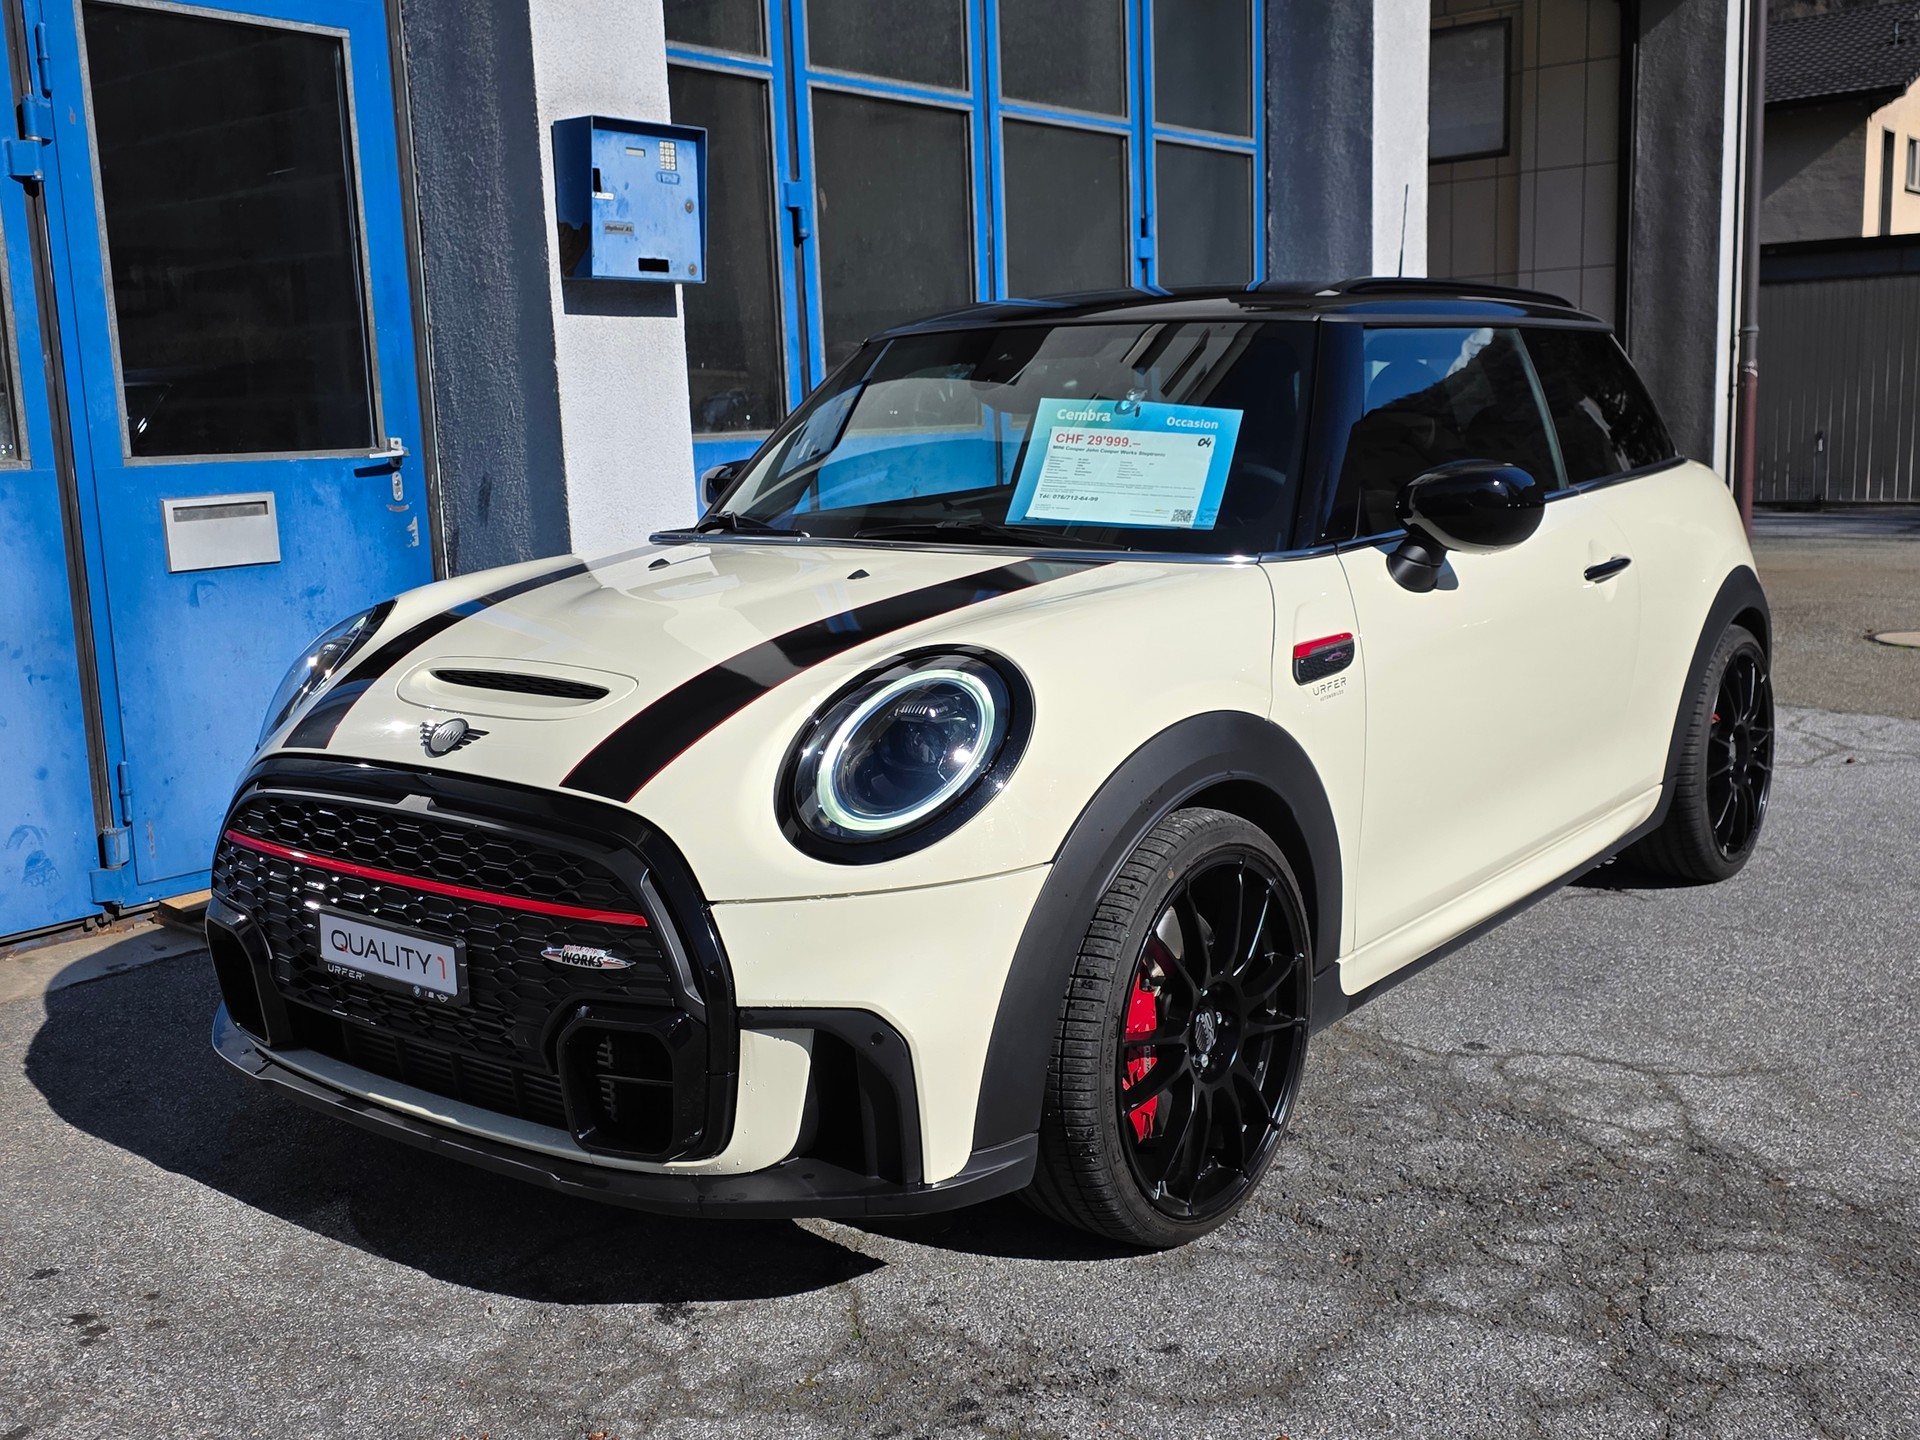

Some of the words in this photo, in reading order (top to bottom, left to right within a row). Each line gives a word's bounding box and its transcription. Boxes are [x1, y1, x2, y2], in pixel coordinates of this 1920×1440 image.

[1056, 408, 1111, 422] Cembra
[1166, 416, 1219, 430] Occasion
[1055, 433, 1085, 444] CHF
[1197, 437, 1212, 448] 04
[1312, 676, 1347, 696] URFER
[562, 950, 604, 968] WORKS
